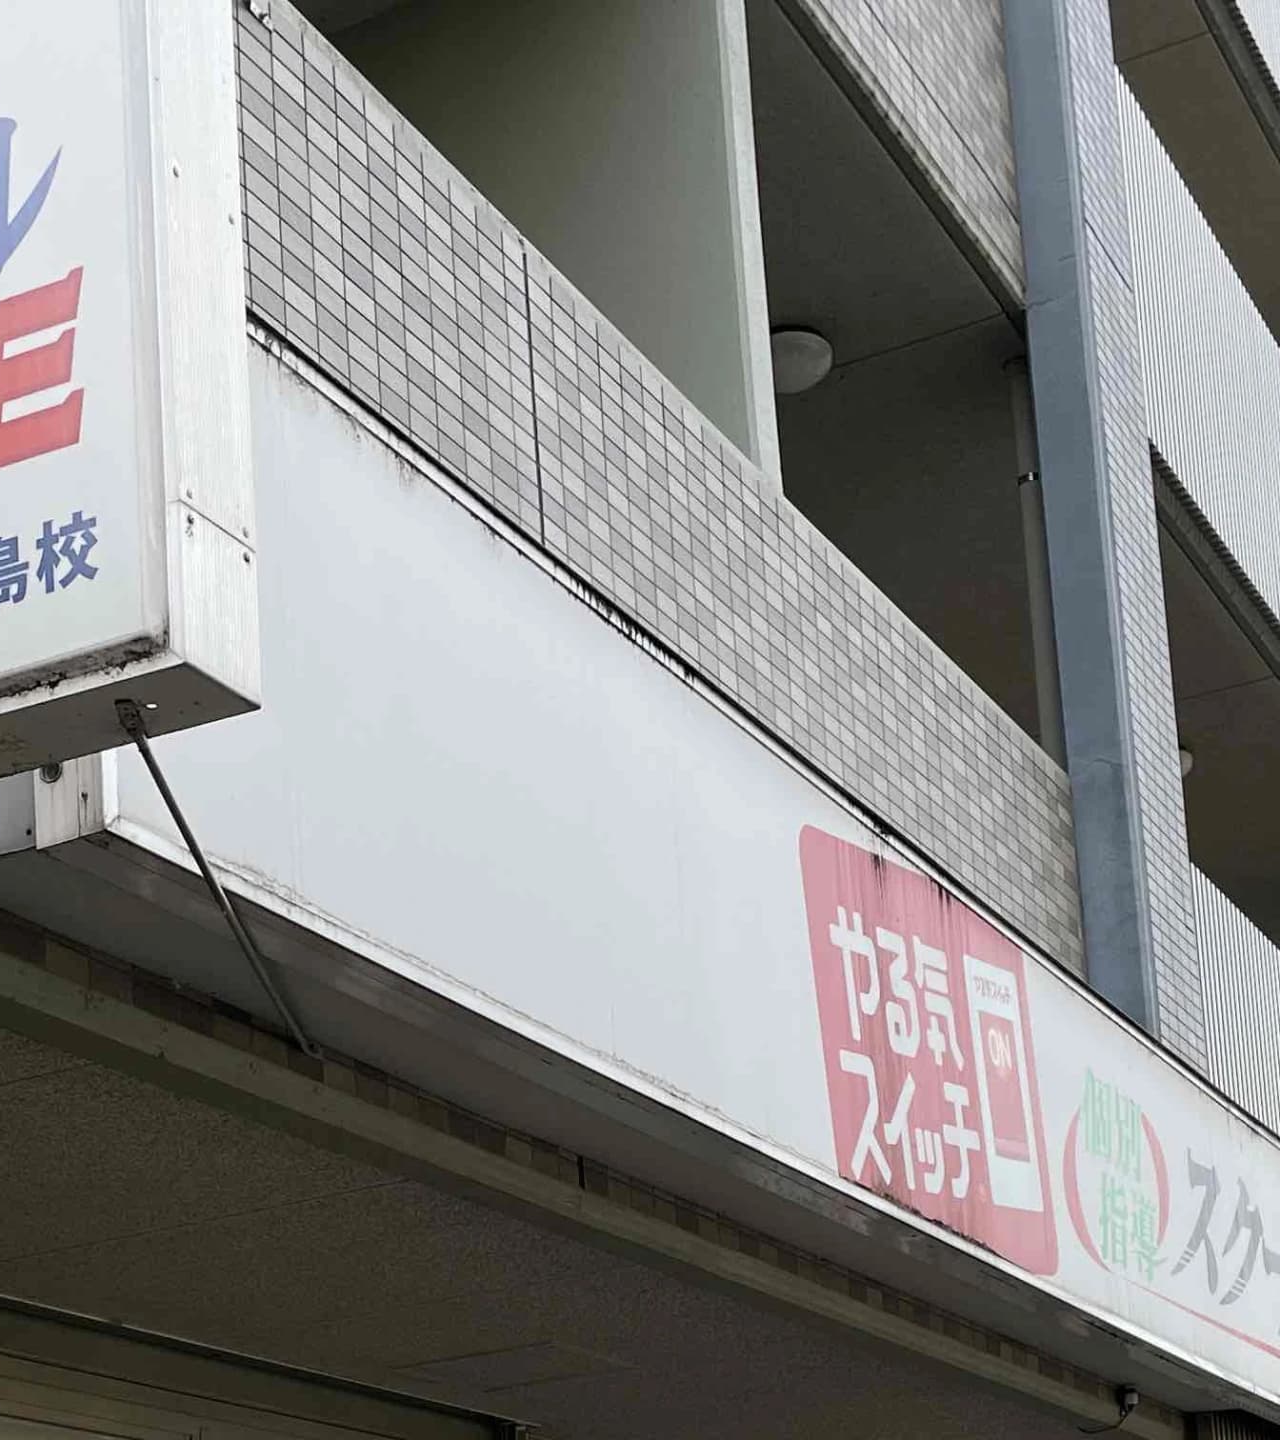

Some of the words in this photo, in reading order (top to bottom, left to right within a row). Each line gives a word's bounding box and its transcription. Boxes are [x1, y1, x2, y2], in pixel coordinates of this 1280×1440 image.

[829, 905, 965, 1070] やる気
[988, 1027, 1013, 1070] ON
[839, 1050, 981, 1199] スイッチ
